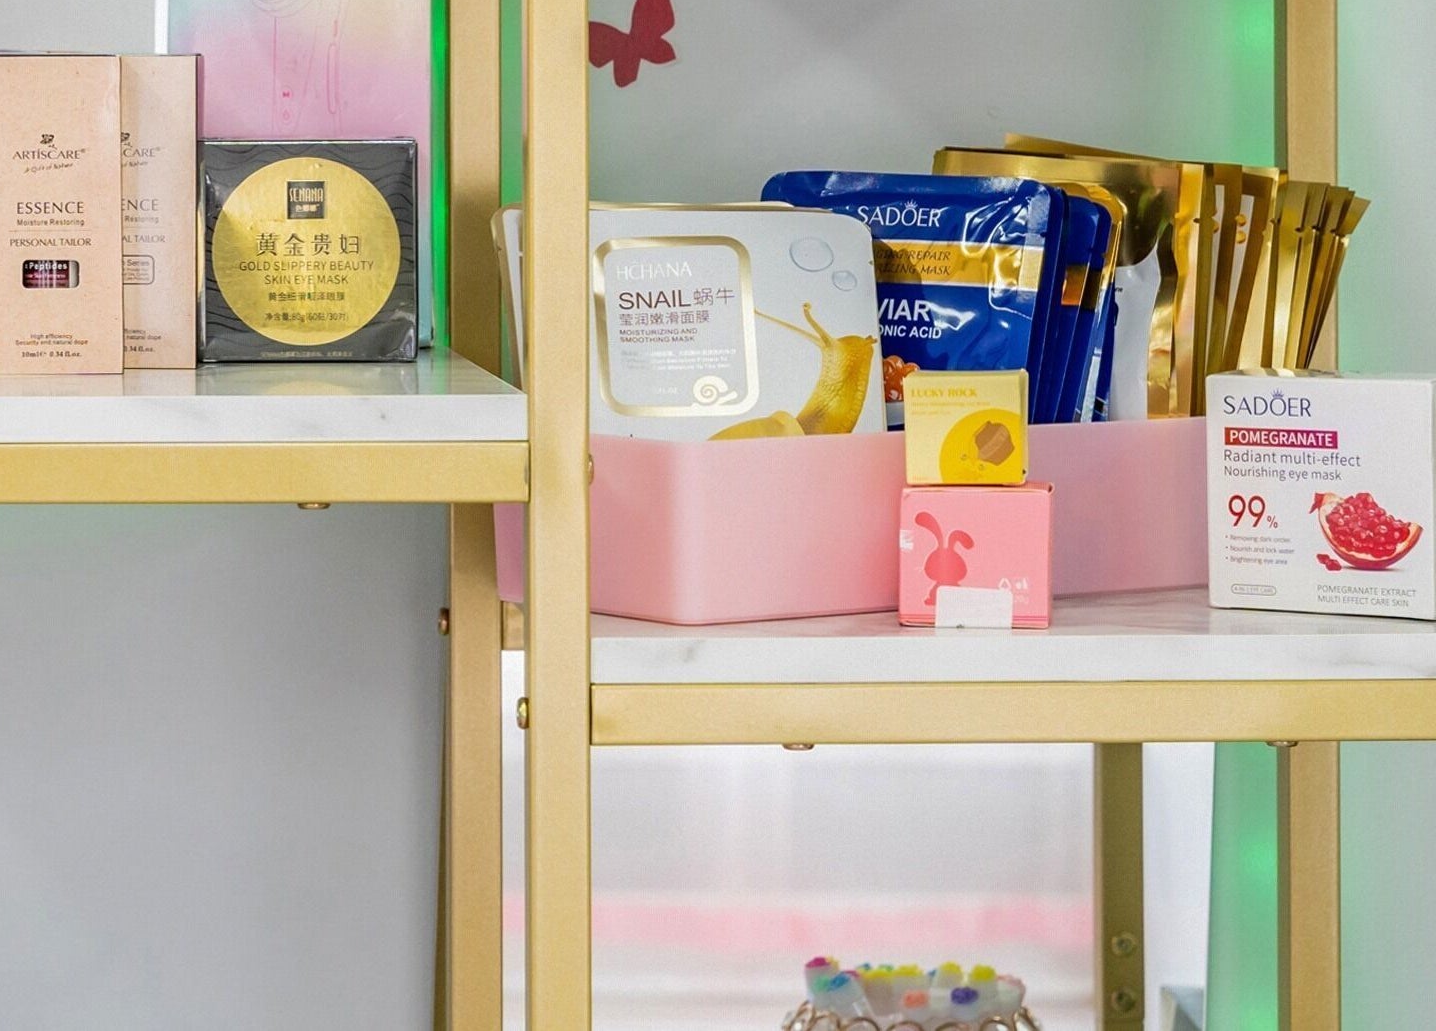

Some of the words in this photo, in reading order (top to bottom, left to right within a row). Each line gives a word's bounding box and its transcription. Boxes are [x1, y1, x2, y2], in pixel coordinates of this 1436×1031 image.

[289, 187, 324, 203] SENANA
[16, 201, 85, 214] ESSENCE
[125, 216, 159, 224] Restoring
[857, 205, 941, 228] SADOER
[50, 219, 85, 227] Restoring
[9, 238, 58, 247] PERSONAL
[60, 238, 92, 247] TAILOR
[134, 235, 165, 243] TAILOR
[256, 232, 360, 257] 黄金贵妇
[909, 250, 951, 261] REPAIR
[29, 262, 68, 272] Peptides
[239, 261, 271, 271] GOLD
[273, 261, 328, 271] SLIPPERY
[330, 261, 374, 271] BEAUTY
[921, 264, 951, 276] MASK
[264, 274, 291, 285] SKIN
[294, 274, 314, 285] EYE
[317, 274, 349, 285] MASK
[619, 289, 692, 310] SNAIL
[693, 287, 735, 306] 蜗牛
[909, 326, 942, 339] ACID
[15, 338, 39, 346] Security
[74, 338, 88, 346] dope
[912, 388, 944, 397] LUCKY
[948, 388, 977, 397] ROCK
[1223, 395, 1311, 417] SADOER
[1229, 430, 1333, 447] POMEGRANATE
[1224, 449, 1277, 464] Radiant
[1280, 452, 1361, 467] multi-effect
[1224, 466, 1286, 481] Nourishing
[1288, 471, 1308, 481] eye
[1311, 469, 1342, 481] mask
[1228, 495, 1278, 529] 99%
[1317, 584, 1379, 596] POMEGRANATE
[1381, 586, 1416, 597] EXTRACT
[1317, 595, 1341, 604] MULTI
[1342, 596, 1368, 605] EFFECT
[1370, 597, 1390, 607] CARE
[1392, 598, 1409, 607] SKIN
